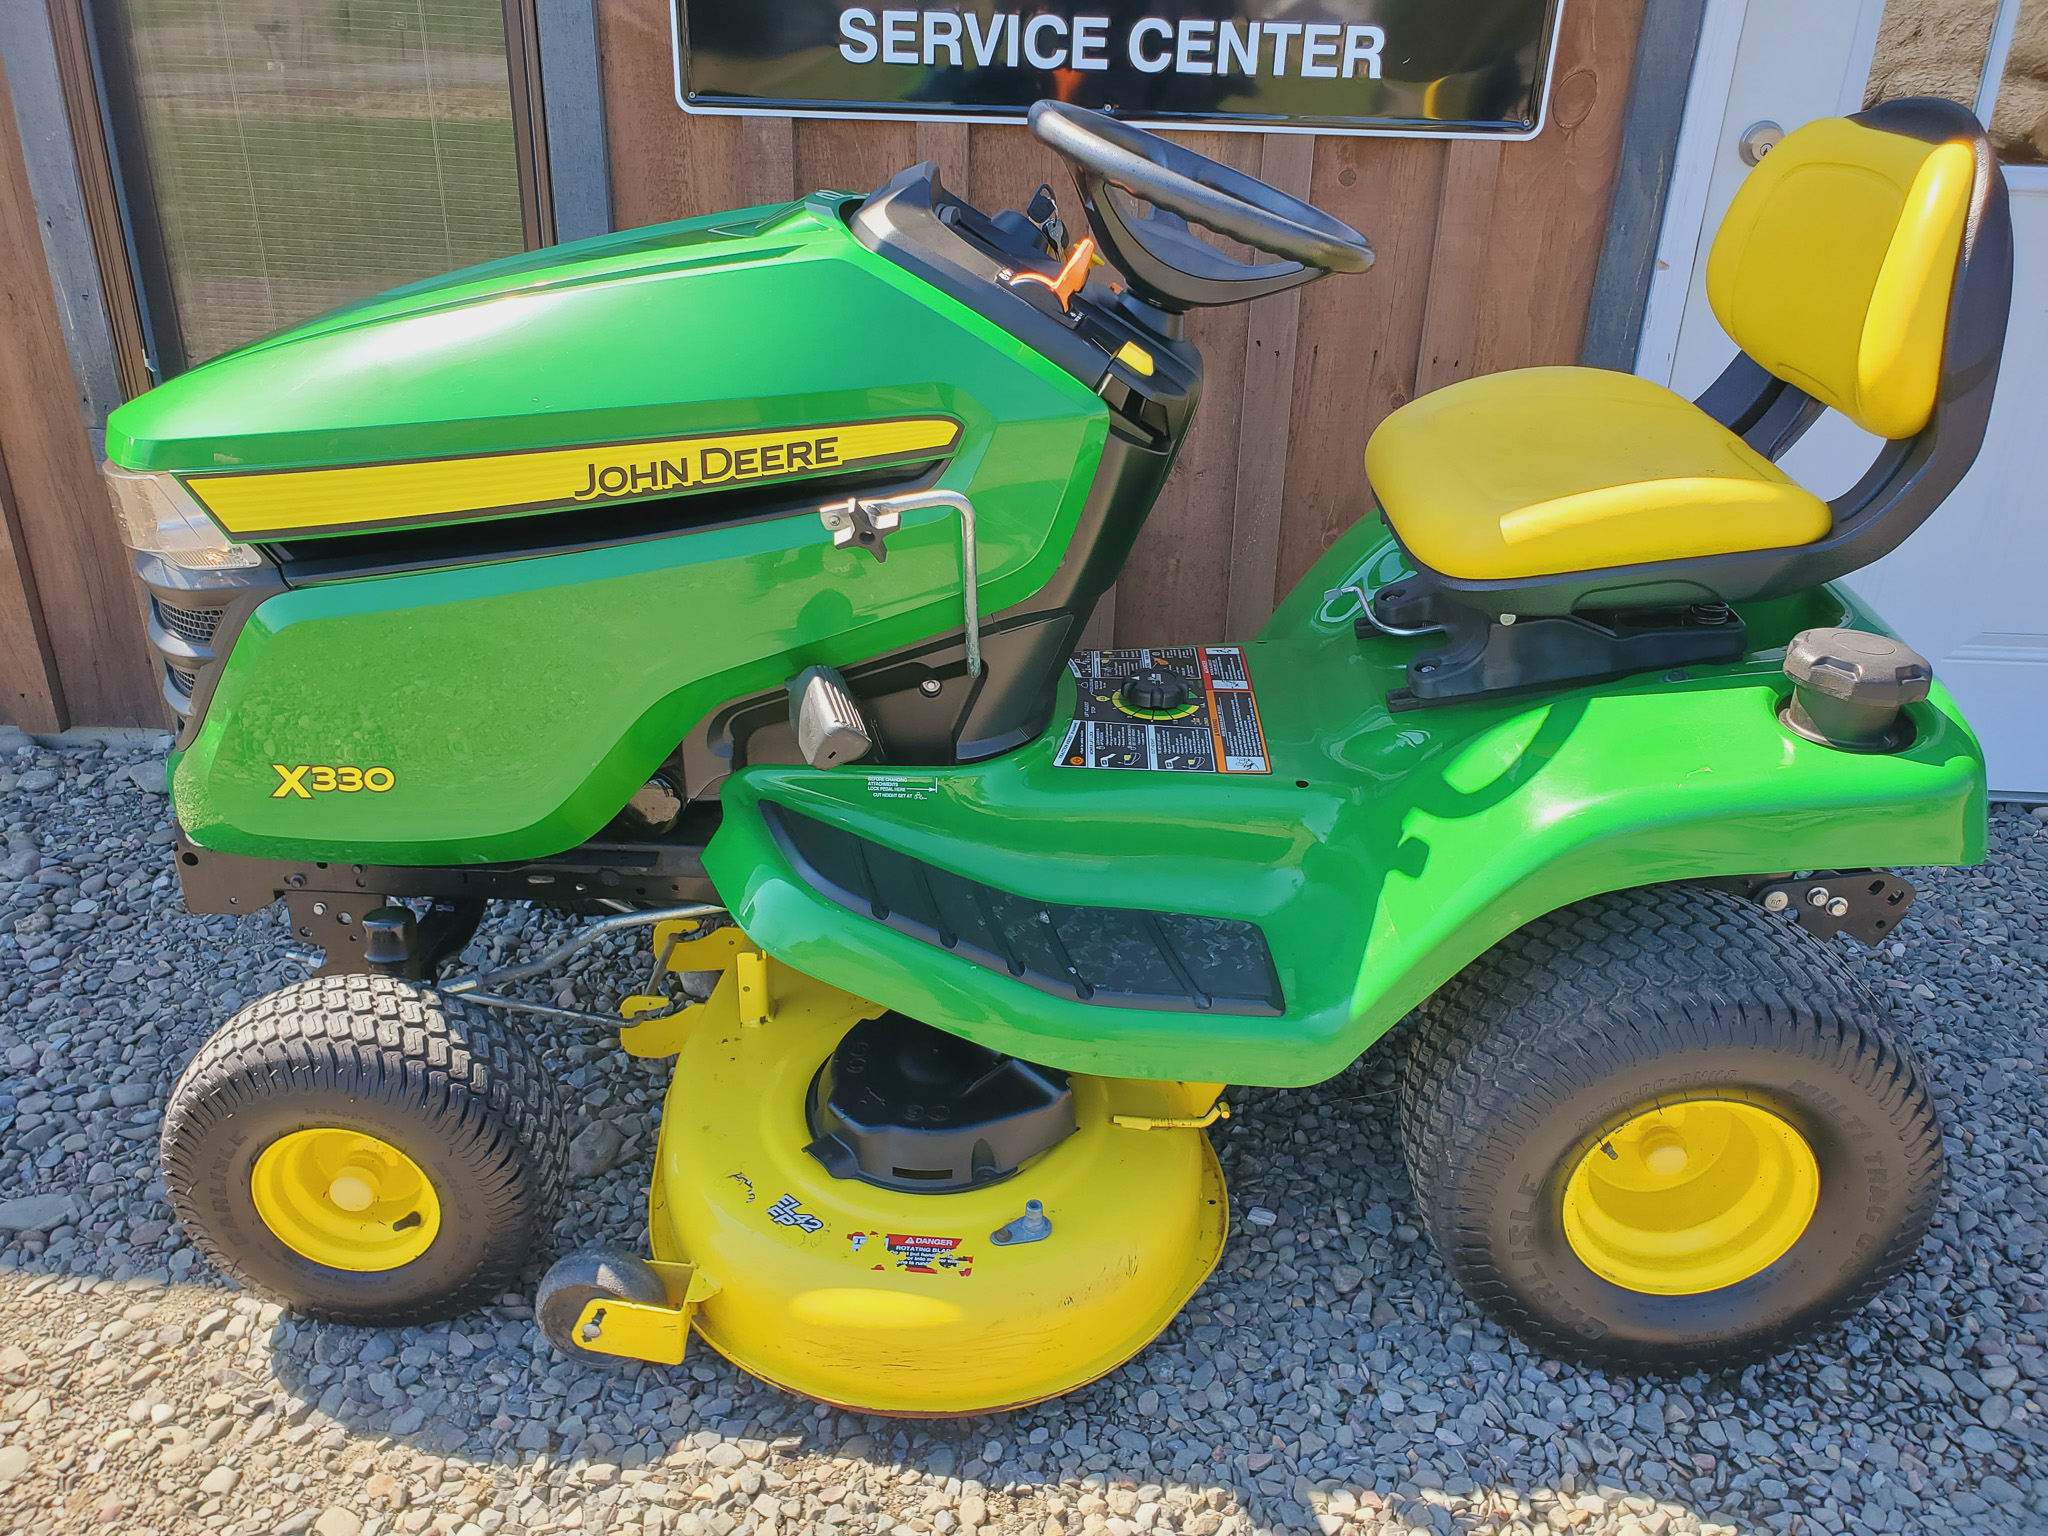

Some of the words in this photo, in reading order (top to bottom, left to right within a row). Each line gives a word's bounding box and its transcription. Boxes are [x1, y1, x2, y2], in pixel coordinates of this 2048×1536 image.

[838, 7, 1112, 71] SERVICE
[1129, 14, 1384, 80] CENTER
[575, 457, 692, 499] JOHN
[700, 436, 840, 485] DEERE
[269, 762, 397, 799] X330
[915, 1238, 953, 1246] DANGER
